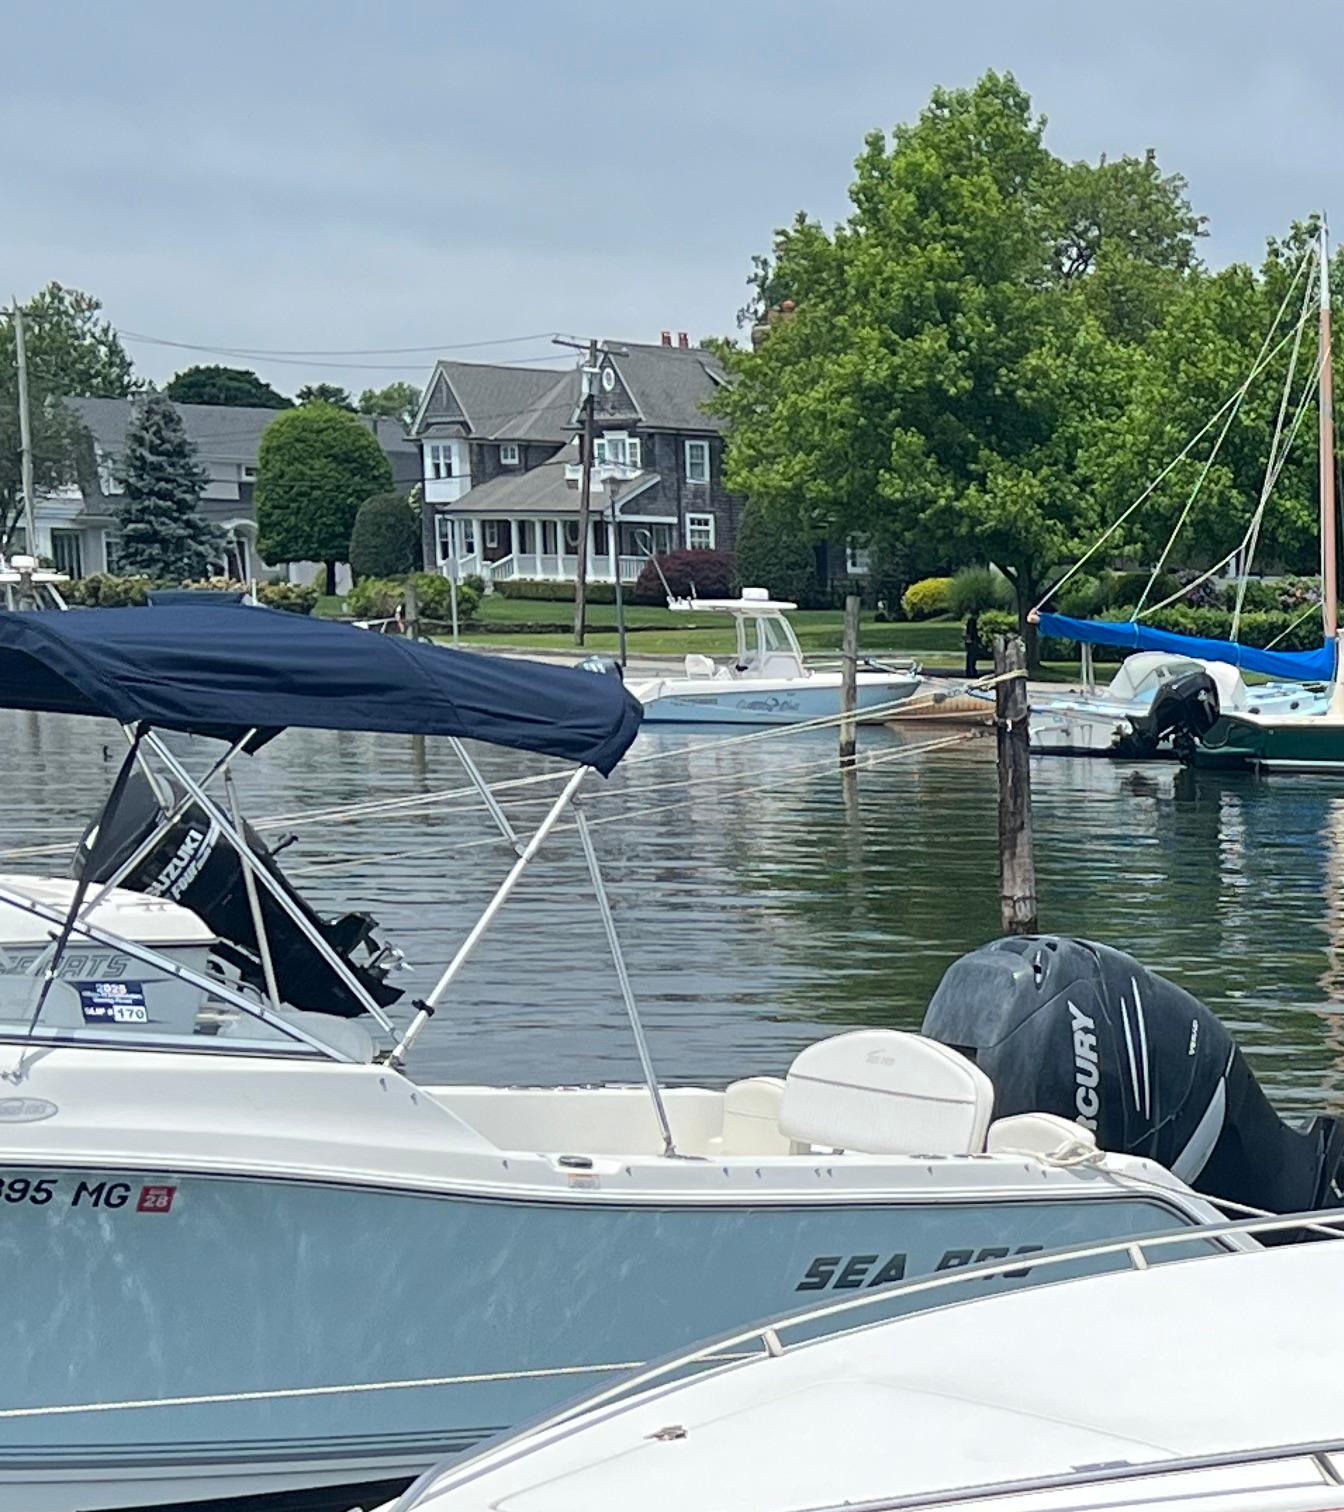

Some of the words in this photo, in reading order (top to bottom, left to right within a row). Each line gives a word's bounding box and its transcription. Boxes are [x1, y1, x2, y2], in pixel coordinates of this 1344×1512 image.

[117, 1008, 144, 1019] 170
[0, 1179, 58, 1205] 95
[71, 1181, 131, 1209] MG
[143, 1195, 169, 1207] 28
[795, 1253, 907, 1291] SEA
